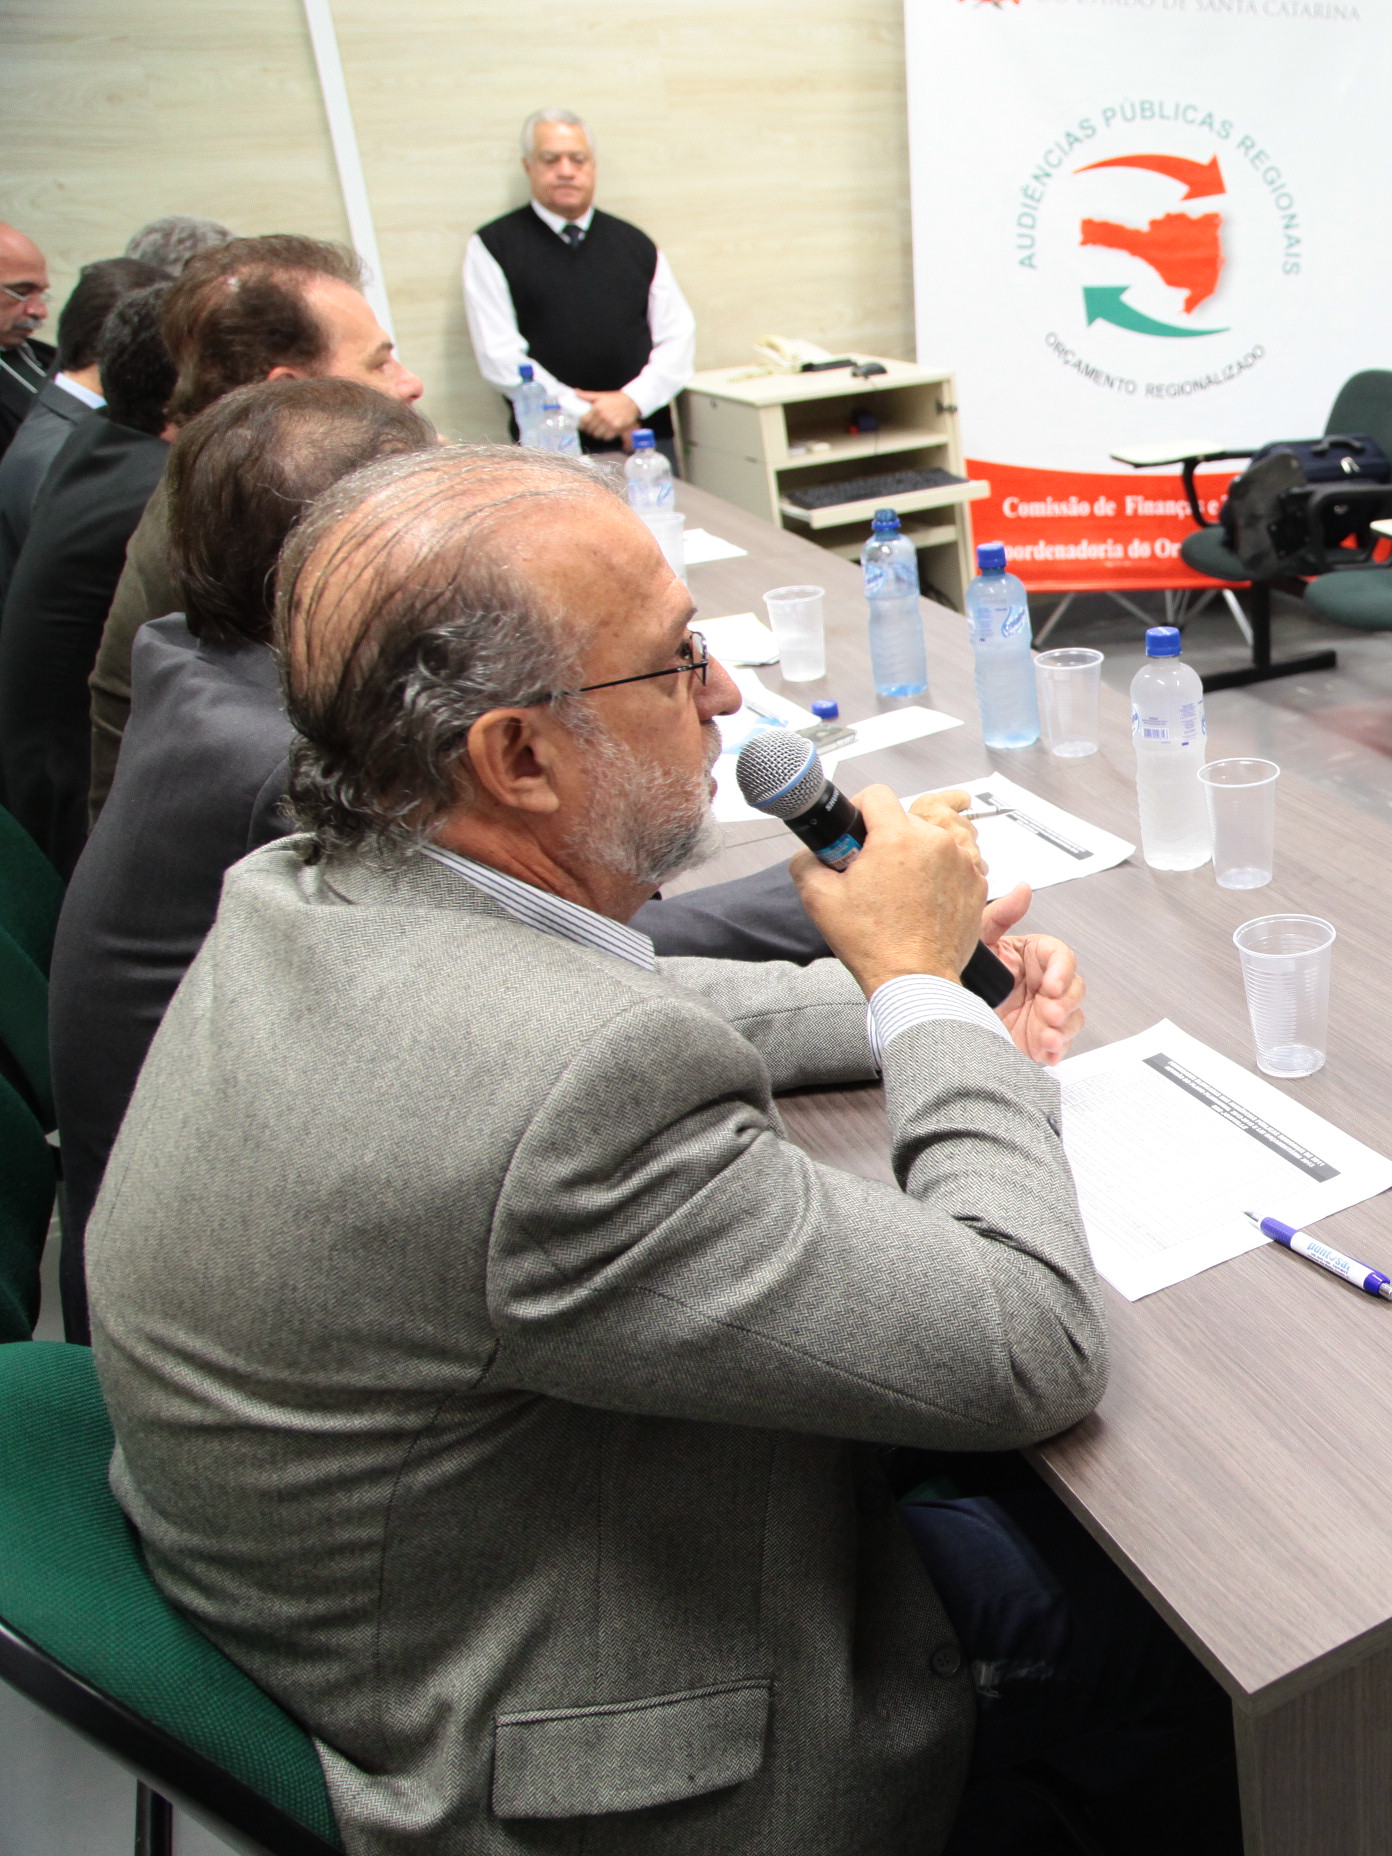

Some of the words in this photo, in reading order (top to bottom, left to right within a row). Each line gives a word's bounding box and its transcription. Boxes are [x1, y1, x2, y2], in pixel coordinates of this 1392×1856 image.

[1262, 0, 1361, 21] CATARINA
[1016, 117, 1097, 270] AUDIÊNCIAS
[1101, 97, 1234, 140] PÚBLICAS
[1236, 133, 1302, 276] REGIONAIS
[1044, 331, 1138, 395] ORÇAMENTO
[1144, 343, 1266, 399] REGIONALIZADO
[1002, 496, 1091, 518] Comissão
[1093, 496, 1117, 517] de
[1206, 499, 1220, 516] e
[991, 538, 1124, 561] oordenadoria
[1127, 537, 1152, 559] do
